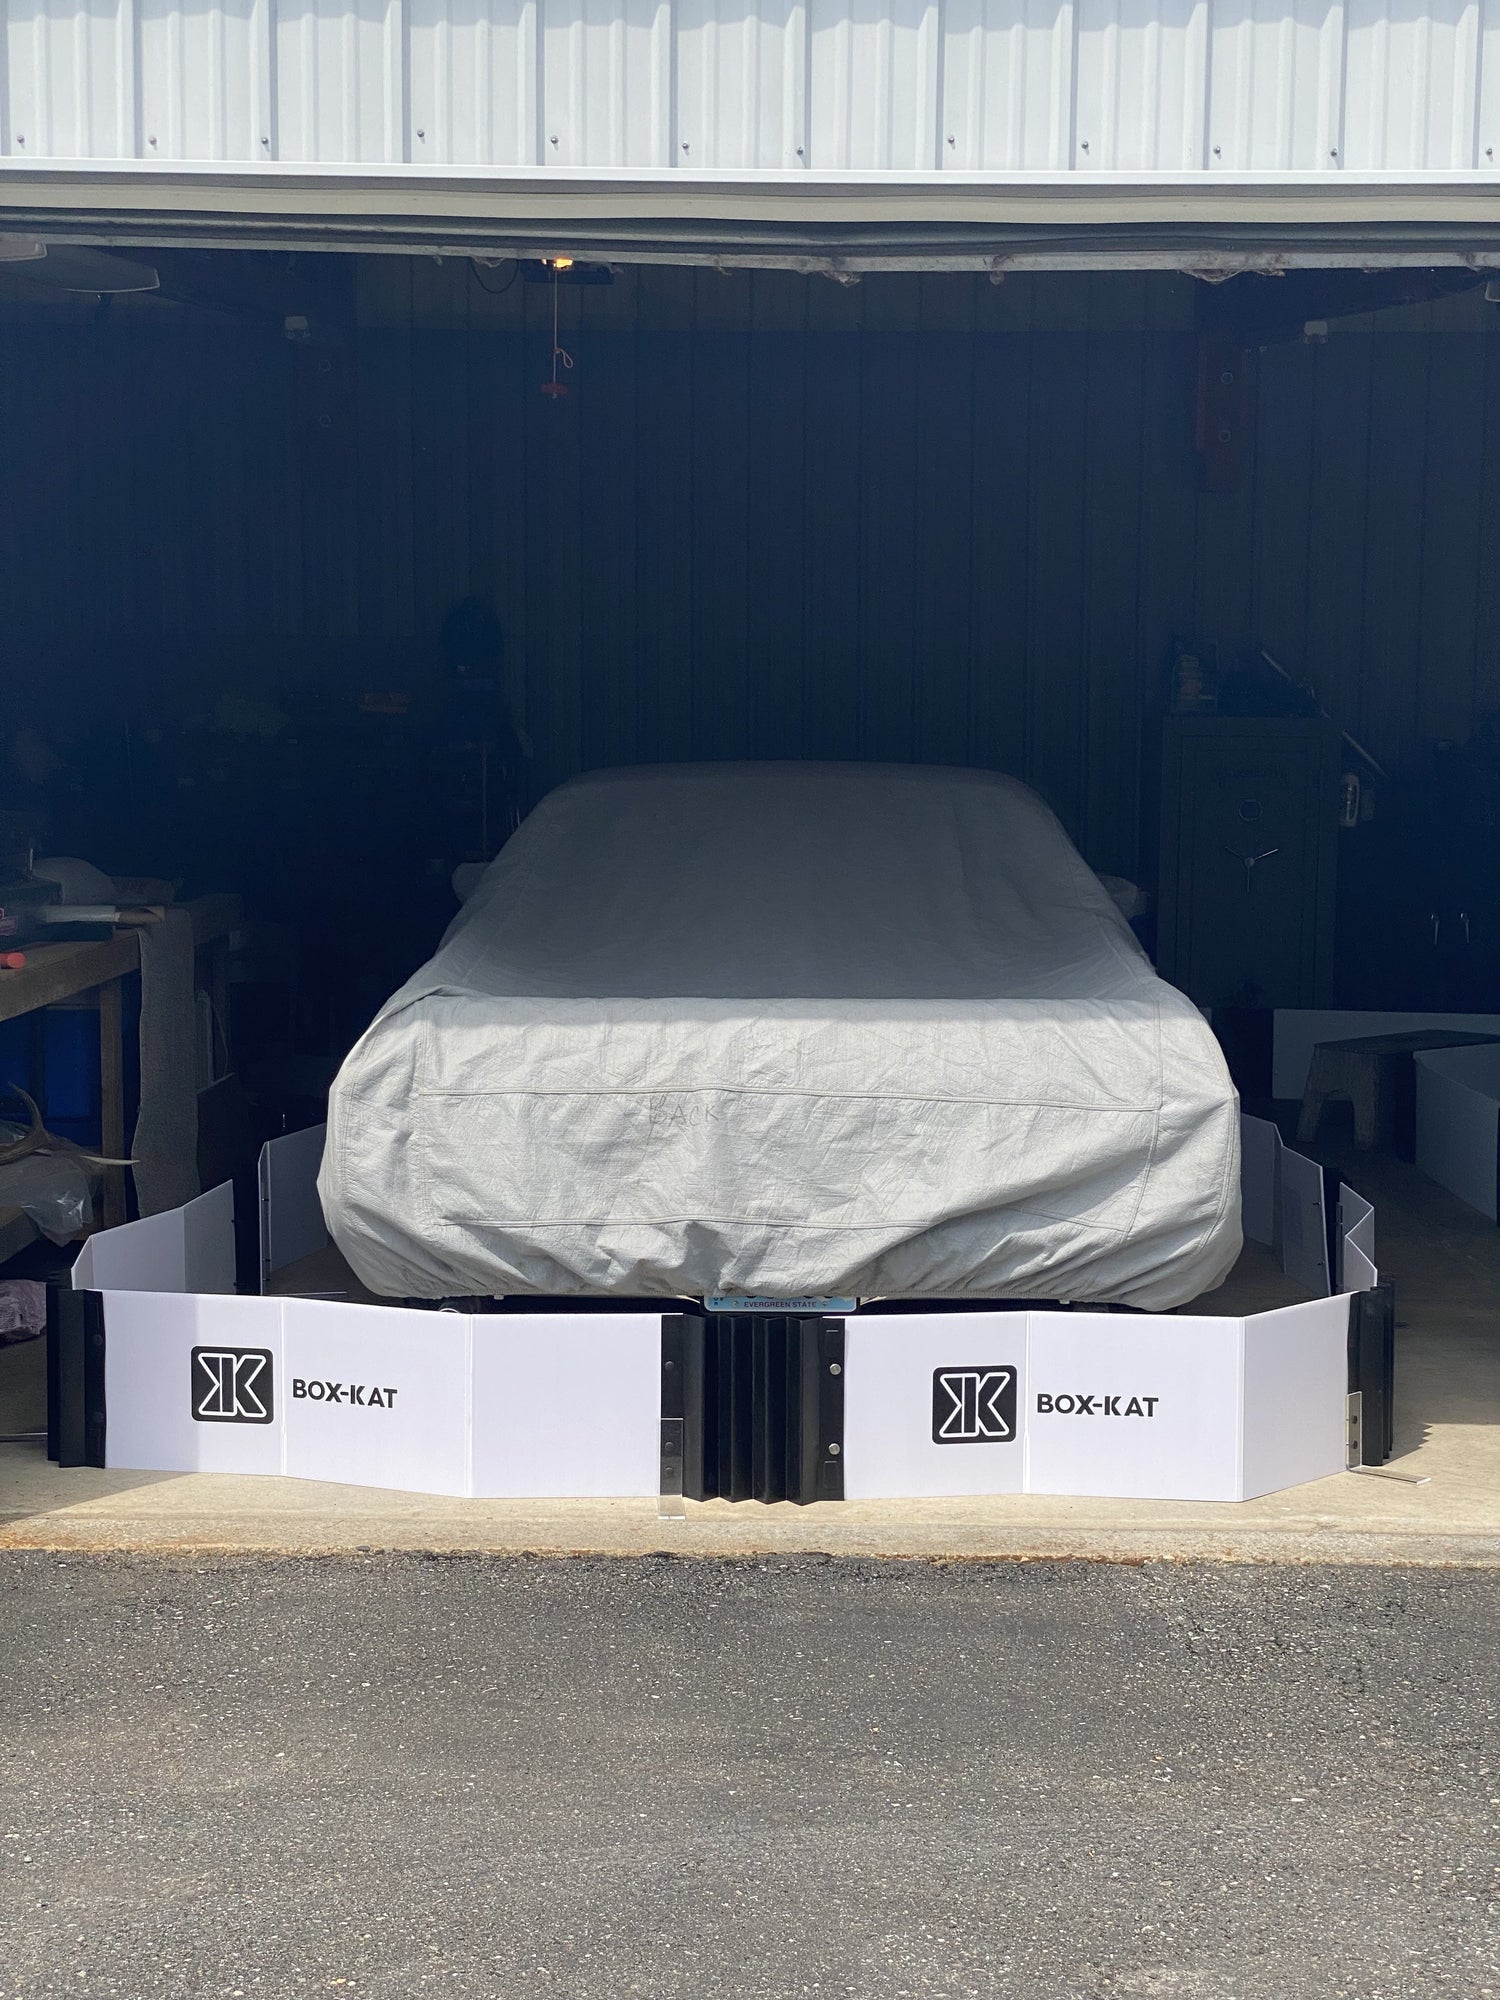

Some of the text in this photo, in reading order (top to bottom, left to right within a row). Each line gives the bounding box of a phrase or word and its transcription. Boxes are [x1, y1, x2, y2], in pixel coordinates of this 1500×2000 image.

[649, 1092, 719, 1127] BACK
[292, 1378, 398, 1409] BOX-KAT
[1036, 1393, 1160, 1417] BOX-KAT
